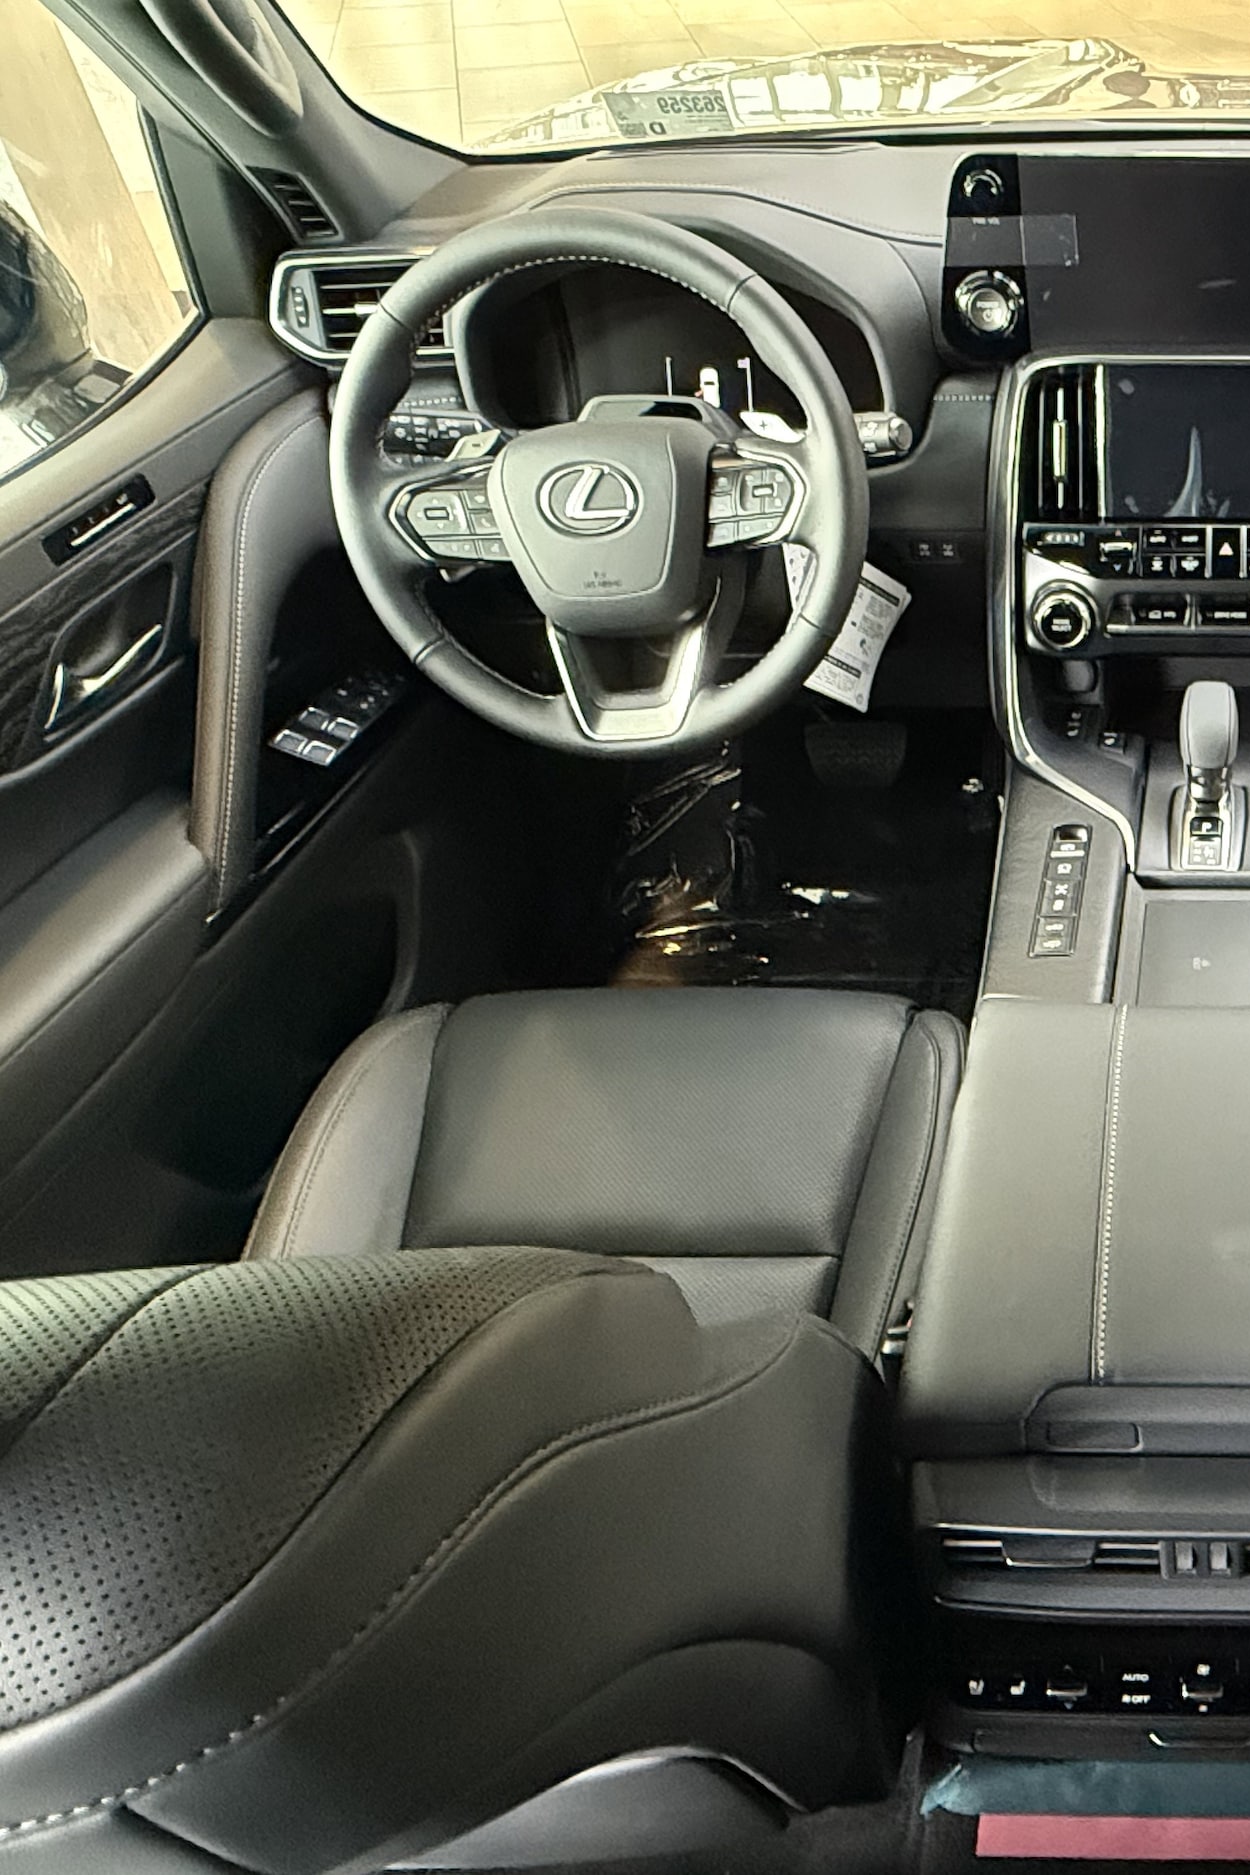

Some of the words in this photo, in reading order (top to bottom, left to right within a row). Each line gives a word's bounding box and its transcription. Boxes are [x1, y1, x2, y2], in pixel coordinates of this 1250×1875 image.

[1201, 821, 1213, 833] P
[1121, 1672, 1150, 1683] AUTO
[1131, 1694, 1152, 1704] OFF
